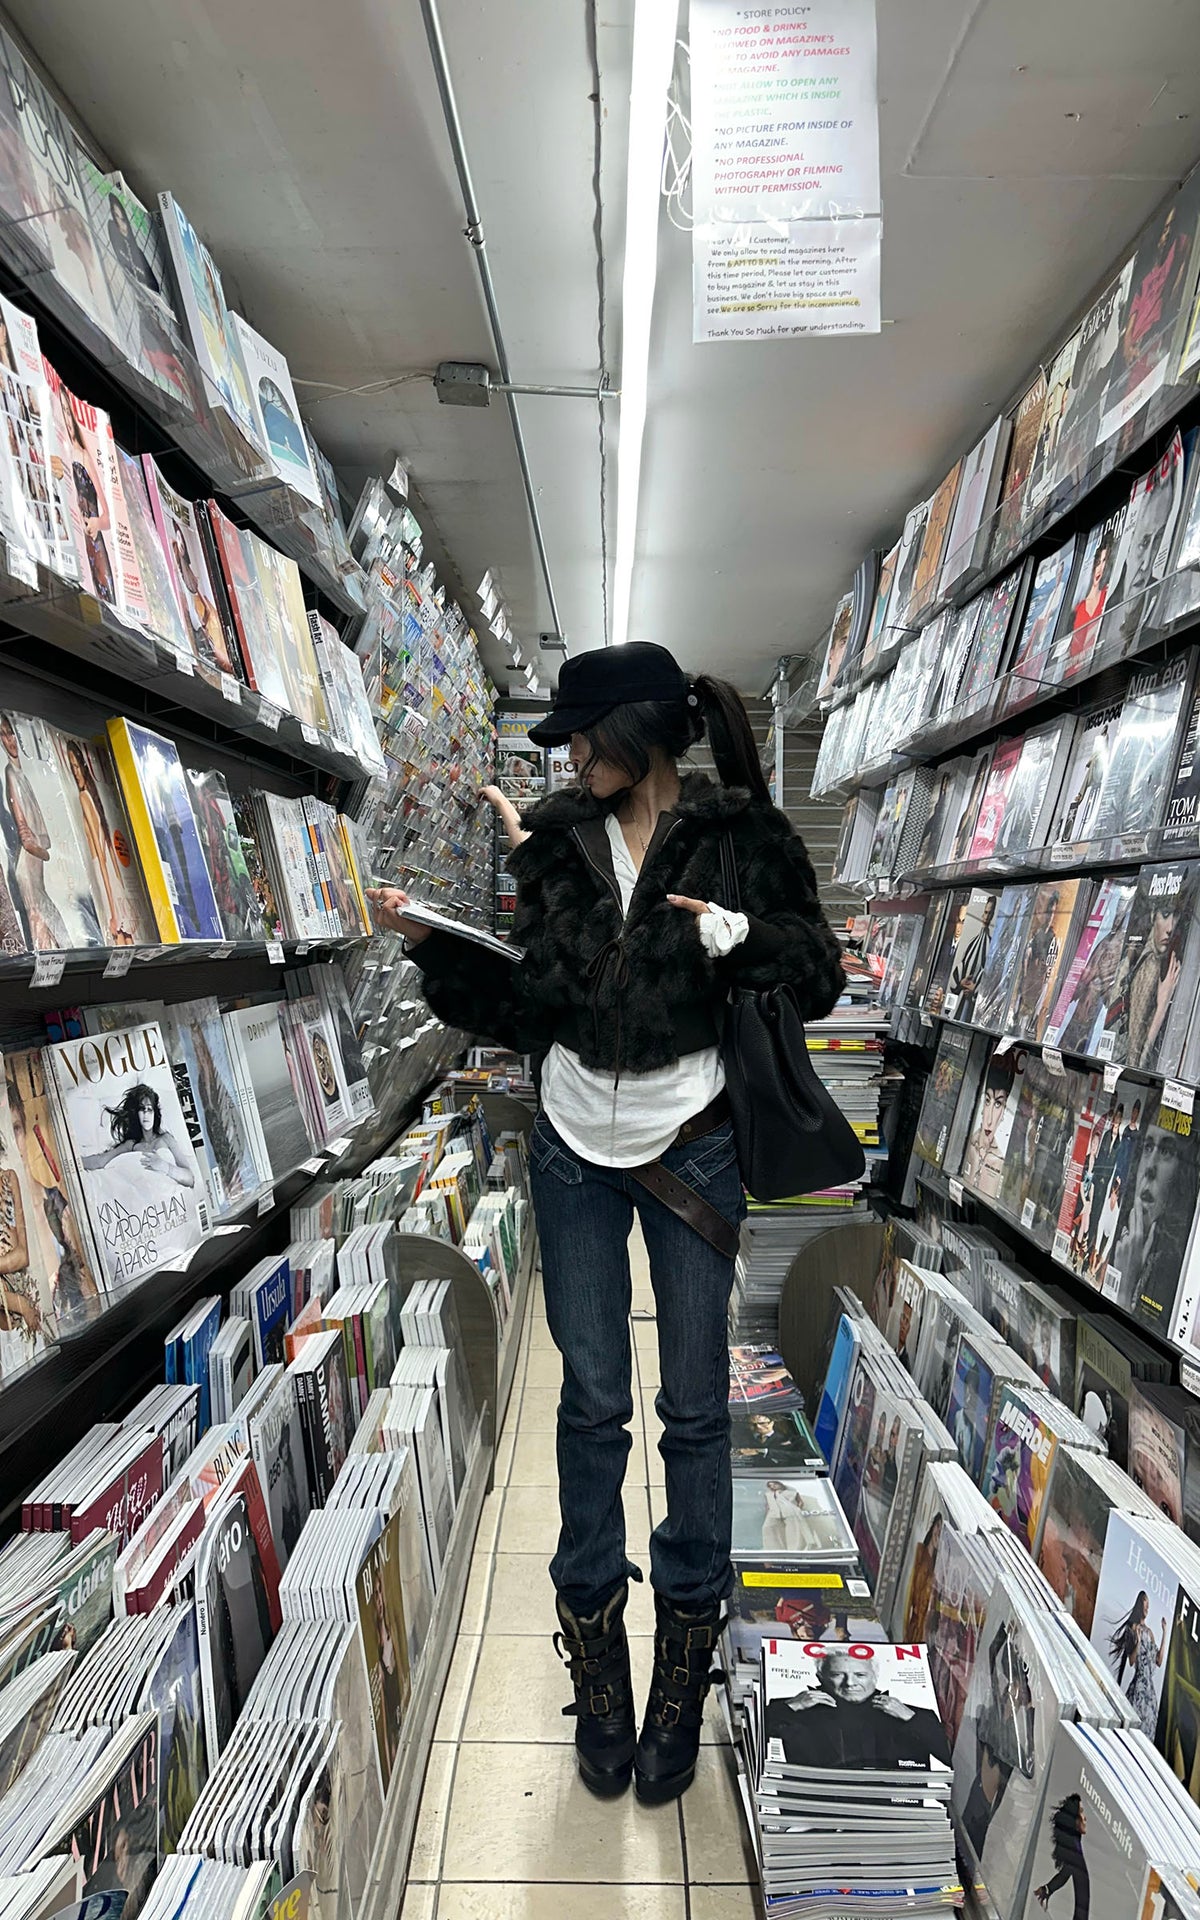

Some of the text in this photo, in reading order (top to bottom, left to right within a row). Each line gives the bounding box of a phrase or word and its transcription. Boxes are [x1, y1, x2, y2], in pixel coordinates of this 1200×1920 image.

[744, 9, 772, 19] STORE
[734, 26, 760, 35] FOOD
[773, 22, 807, 32] DRINKS
[750, 51, 778, 60] AVOID
[781, 49, 801, 58] ANY
[804, 47, 850, 56] DAMAGES
[740, 81, 773, 90] ALLOW
[790, 78, 815, 87] OPEN
[818, 77, 839, 85] ANY
[766, 92, 798, 101] WHICH
[811, 90, 842, 99] INSIDE
[736, 124, 774, 134] PICTURE
[777, 121, 805, 131] FROM
[807, 120, 837, 130] INSIDE
[840, 120, 854, 128] OF
[714, 138, 788, 150] ANY MAGAZINE.
[736, 152, 805, 165] PROFESSIONAL
[714, 165, 843, 181] PHOTOGRAPHY OR FILMING
[715, 181, 822, 195] WITHOUT PERMISSION.
[754, 237, 790, 245] Customer,
[723, 249, 738, 257] only
[740, 247, 758, 255] allow
[788, 246, 826, 256] magazines
[828, 245, 844, 253] here
[707, 260, 725, 268] from
[733, 259, 747, 267] AM
[788, 257, 800, 265] the
[835, 256, 857, 264] After
[707, 271, 722, 279] this
[768, 268, 791, 276] Please
[793, 267, 803, 276] let
[819, 267, 857, 275] customers
[717, 283, 730, 292] buy
[732, 281, 766, 290] magazine
[798, 280, 815, 288] stay
[741, 292, 751, 300] We
[753, 291, 771, 299] don't
[792, 290, 803, 298] big
[757, 303, 777, 311] Sorry
[780, 301, 791, 309] for
[793, 300, 806, 308] the
[707, 330, 729, 338] Thank
[746, 328, 755, 336] So
[756, 327, 775, 335] Much
[777, 326, 789, 334] for
[791, 326, 807, 334] your
[810, 323, 865, 332] understanding.
[1170, 795, 1196, 818] TOM
[59, 1027, 166, 1087] VOGUE
[172, 1063, 205, 1149] METAL
[102, 1193, 186, 1250] KARDASHIAN
[260, 1273, 286, 1322] Ursula
[316, 1365, 332, 1444] DAMN
[1000, 1400, 1052, 1464] MERDE
[213, 1429, 241, 1485] BLANC
[199, 1606, 207, 1637] Numéro
[769, 1639, 921, 1660] ICON
[1080, 1767, 1133, 1859] human shift
